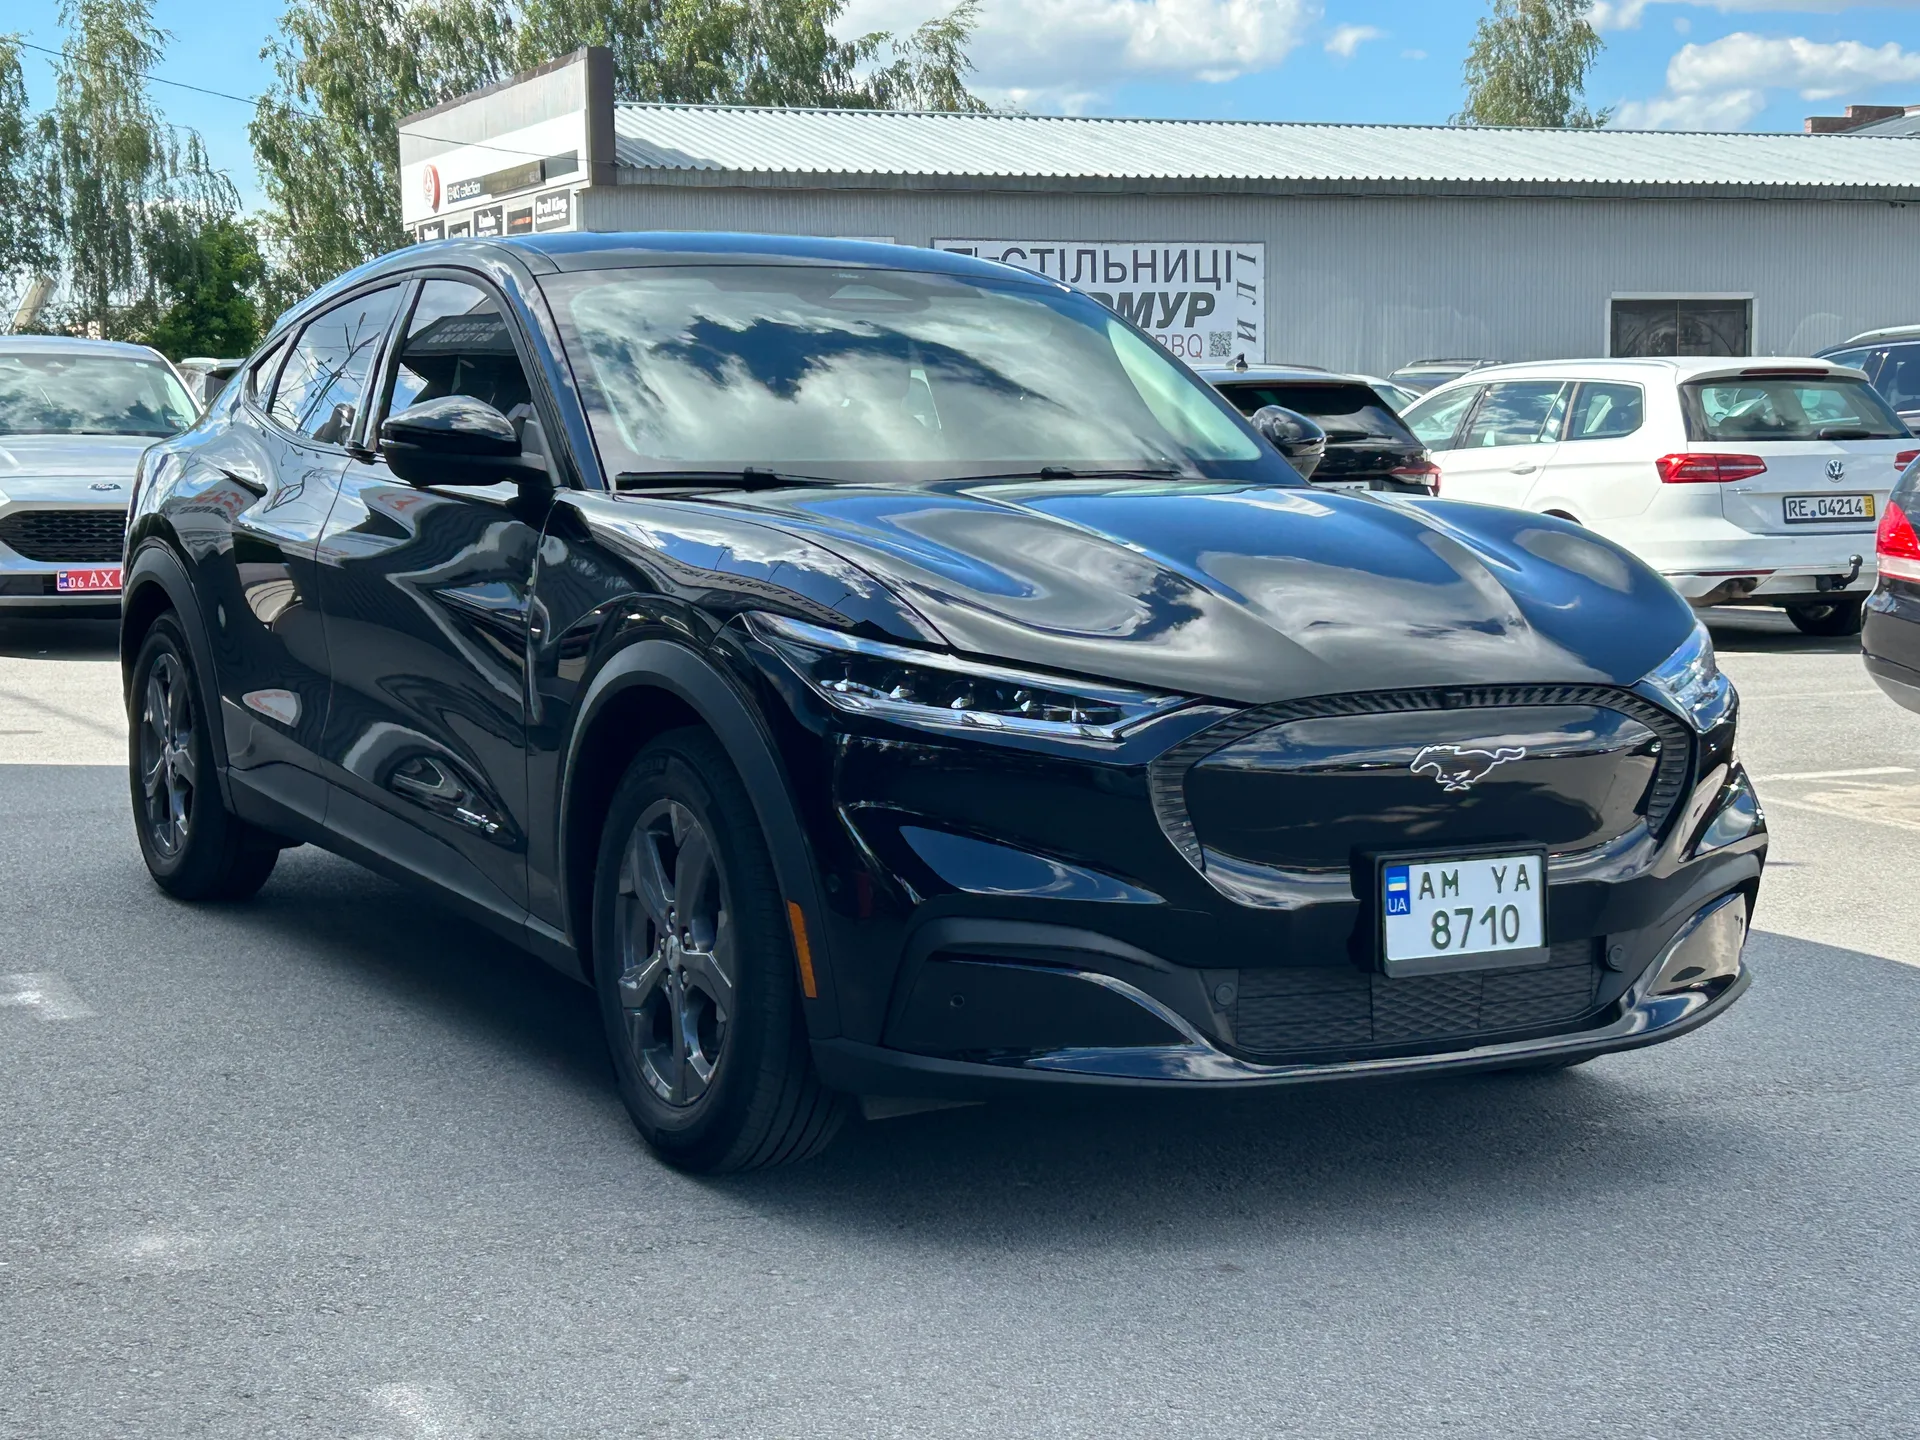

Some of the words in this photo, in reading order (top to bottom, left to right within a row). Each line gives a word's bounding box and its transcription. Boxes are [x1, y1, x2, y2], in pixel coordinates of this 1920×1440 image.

[1418, 868, 1460, 900] AM
[1491, 863, 1531, 894] YA
[1387, 896, 1408, 913] UA
[1431, 903, 1520, 951] 8710
